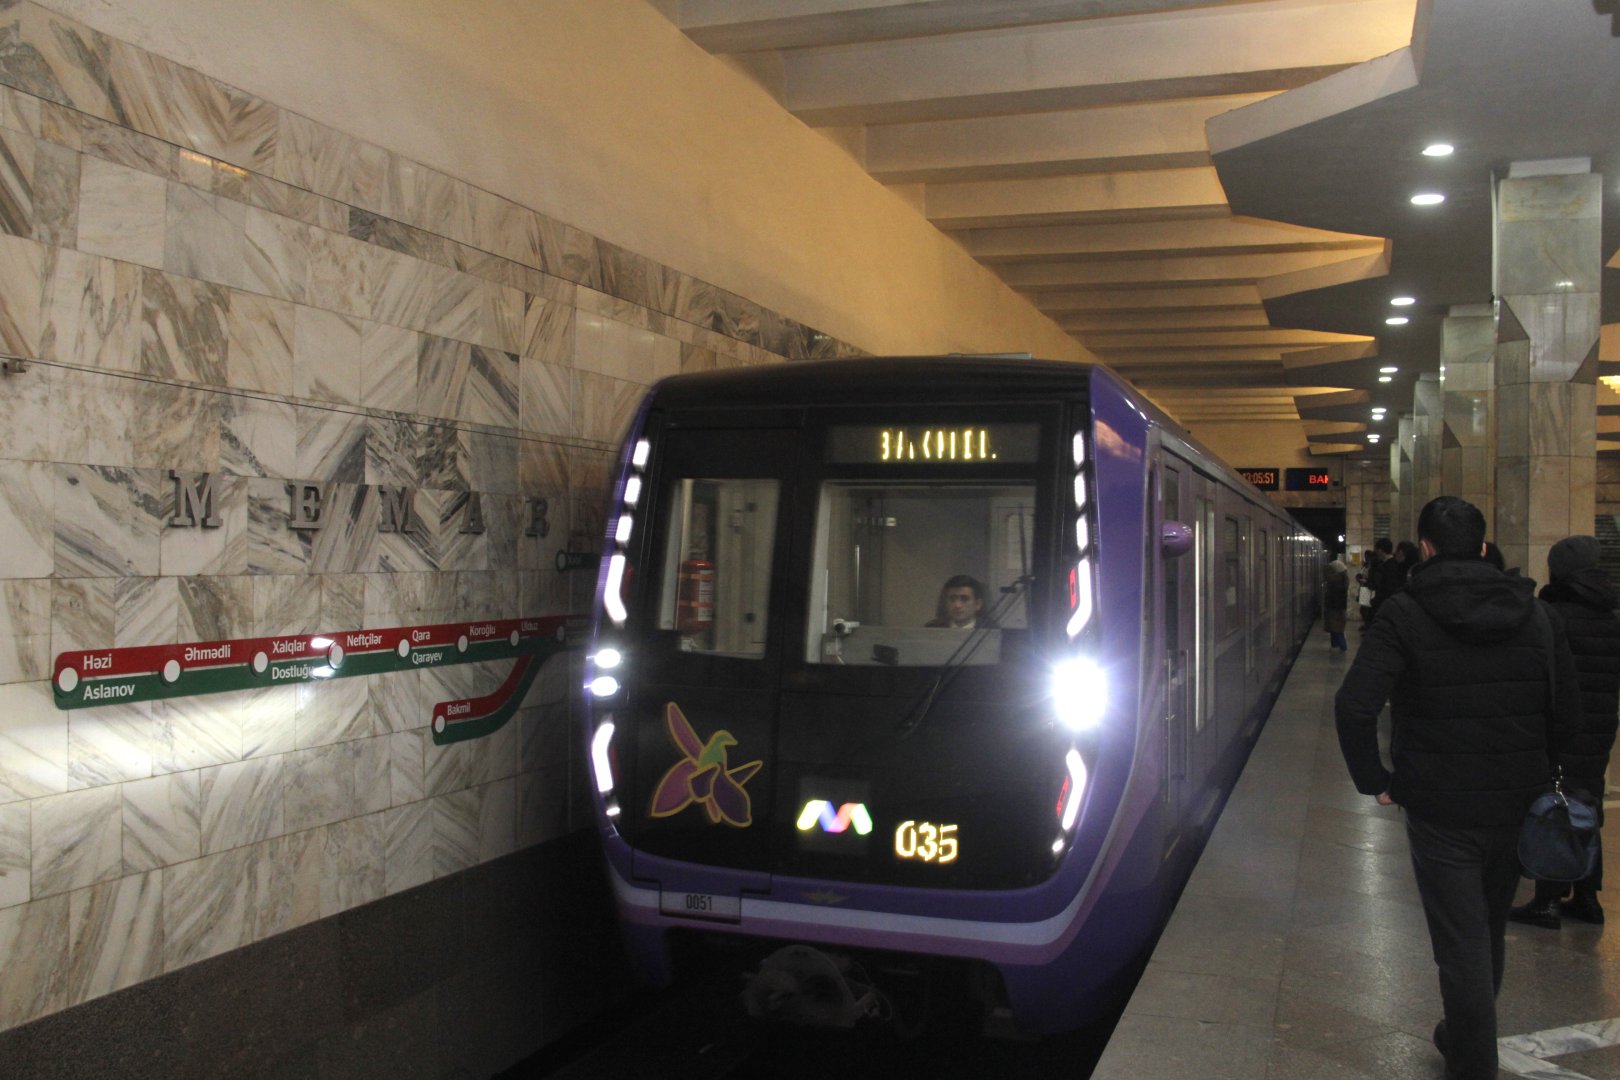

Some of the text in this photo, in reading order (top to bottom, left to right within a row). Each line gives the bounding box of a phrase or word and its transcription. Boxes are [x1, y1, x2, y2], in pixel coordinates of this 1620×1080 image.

[412, 630, 431, 642] Qara
[469, 624, 497, 638] Koroğlu
[272, 639, 307, 655] Xalqlar
[346, 634, 382, 648] Neftçilər
[184, 644, 231, 662] Əhmədli
[412, 652, 442, 665] Qarayev
[83, 653, 113, 671] Həzi
[83, 684, 136, 701] Aslanov
[894, 819, 959, 863] 035
[685, 893, 713, 912] 0051
